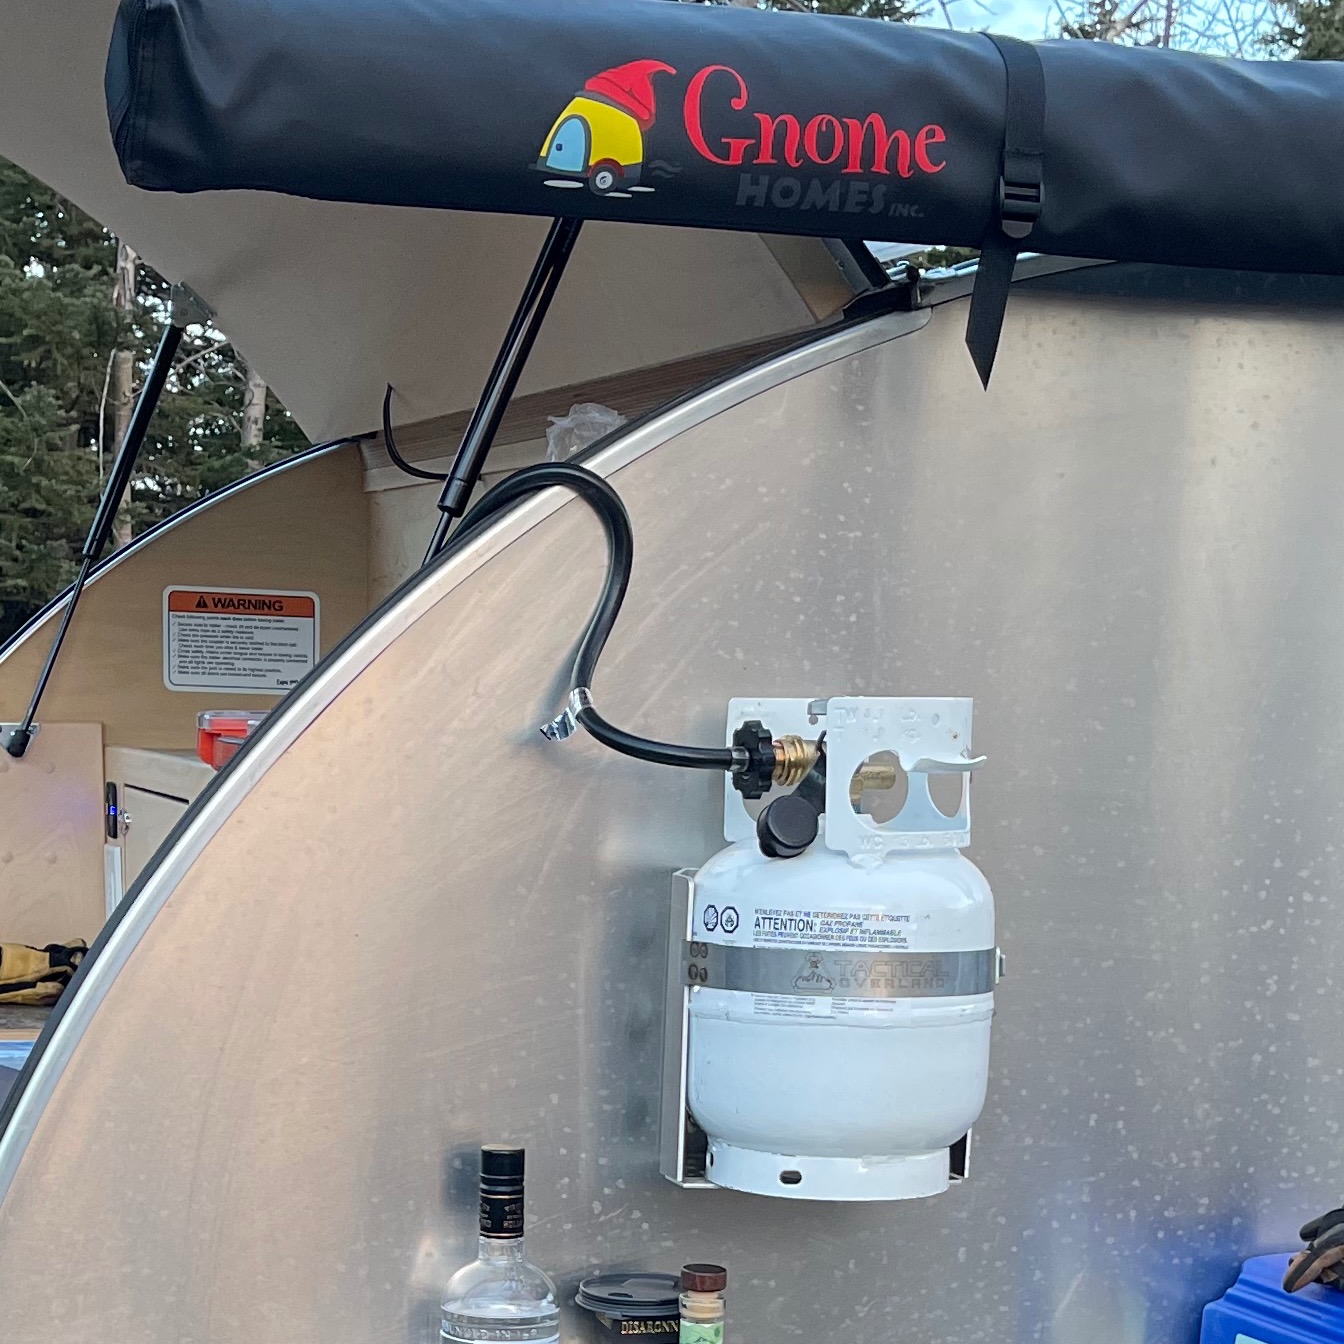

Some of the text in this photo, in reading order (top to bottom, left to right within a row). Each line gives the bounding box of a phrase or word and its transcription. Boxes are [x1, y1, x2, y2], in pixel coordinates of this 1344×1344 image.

[683, 64, 947, 178] Gnome
[735, 173, 925, 219] HOMES INC.
[211, 596, 284, 612] WARNING
[834, 959, 949, 978] TACTICAL
[839, 977, 946, 990] OVERLAND
[621, 1321, 679, 1335] DISARONN
